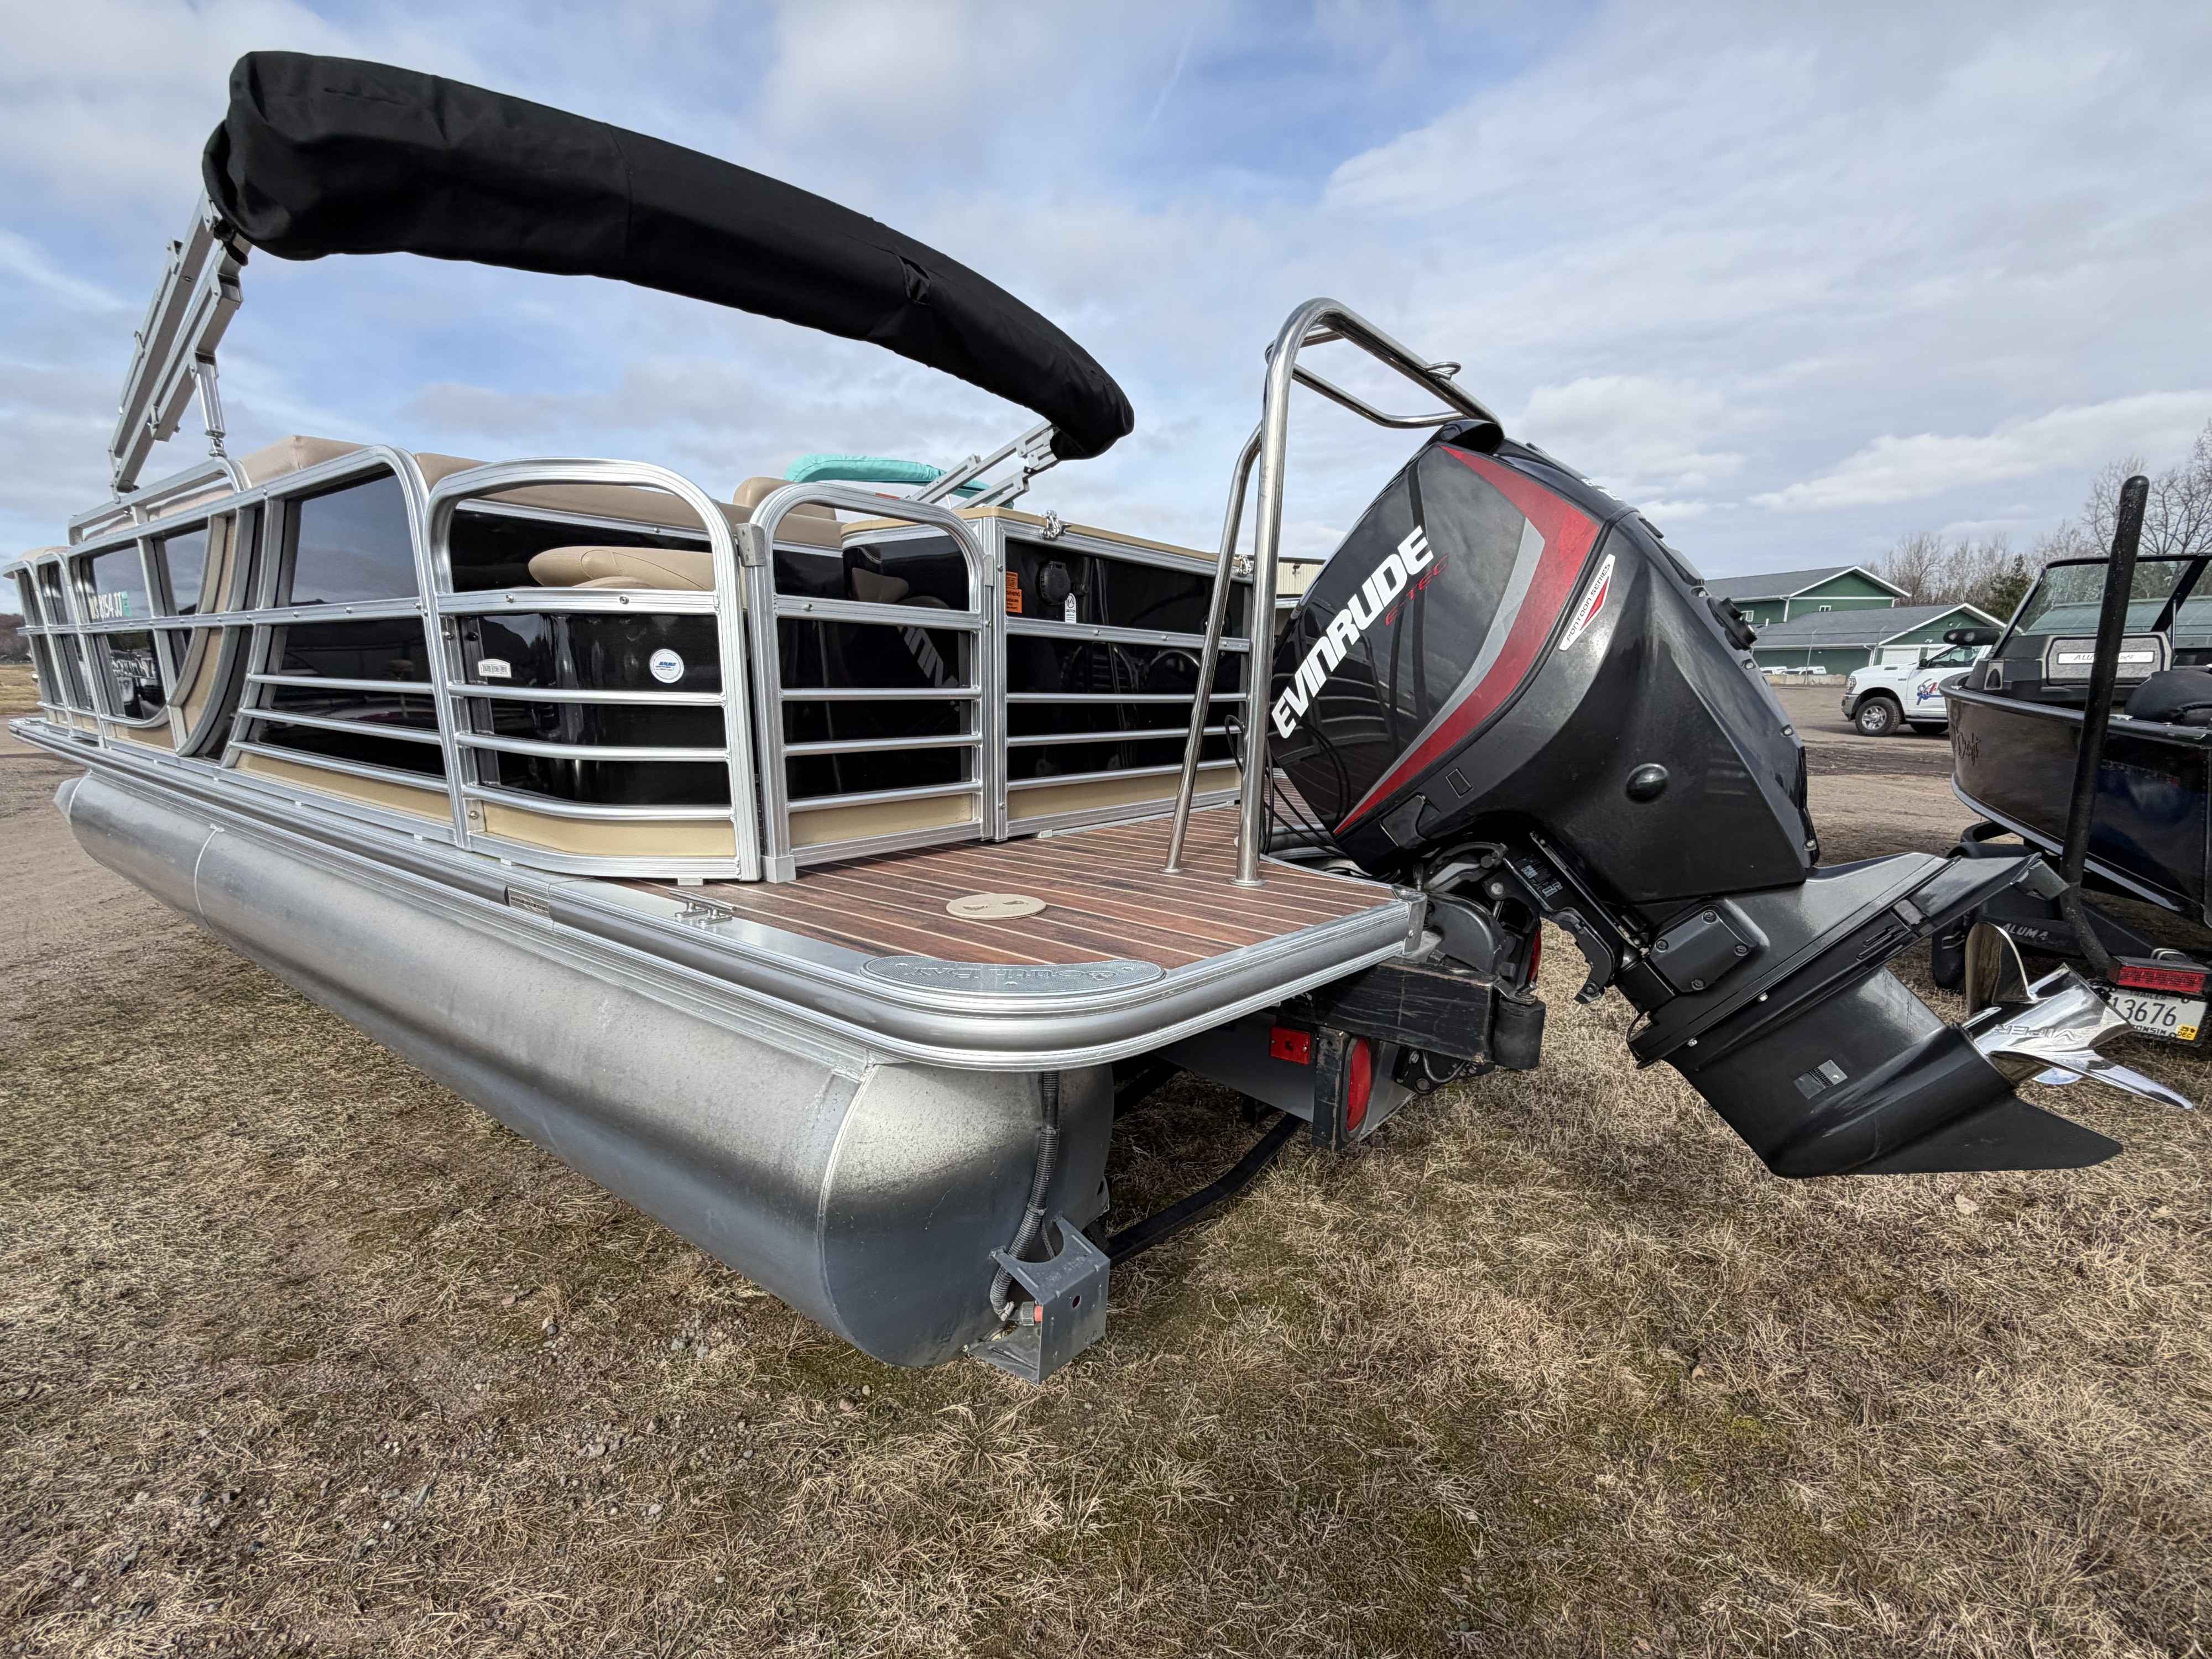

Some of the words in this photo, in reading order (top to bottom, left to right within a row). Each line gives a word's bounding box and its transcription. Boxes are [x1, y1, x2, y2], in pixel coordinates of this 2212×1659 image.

[1271, 525, 1434, 739] EVINRUDE
[1567, 597, 1592, 642] PONTOON
[1590, 564, 1610, 597] SERIES
[2133, 1025, 2167, 1035] ONSIN
